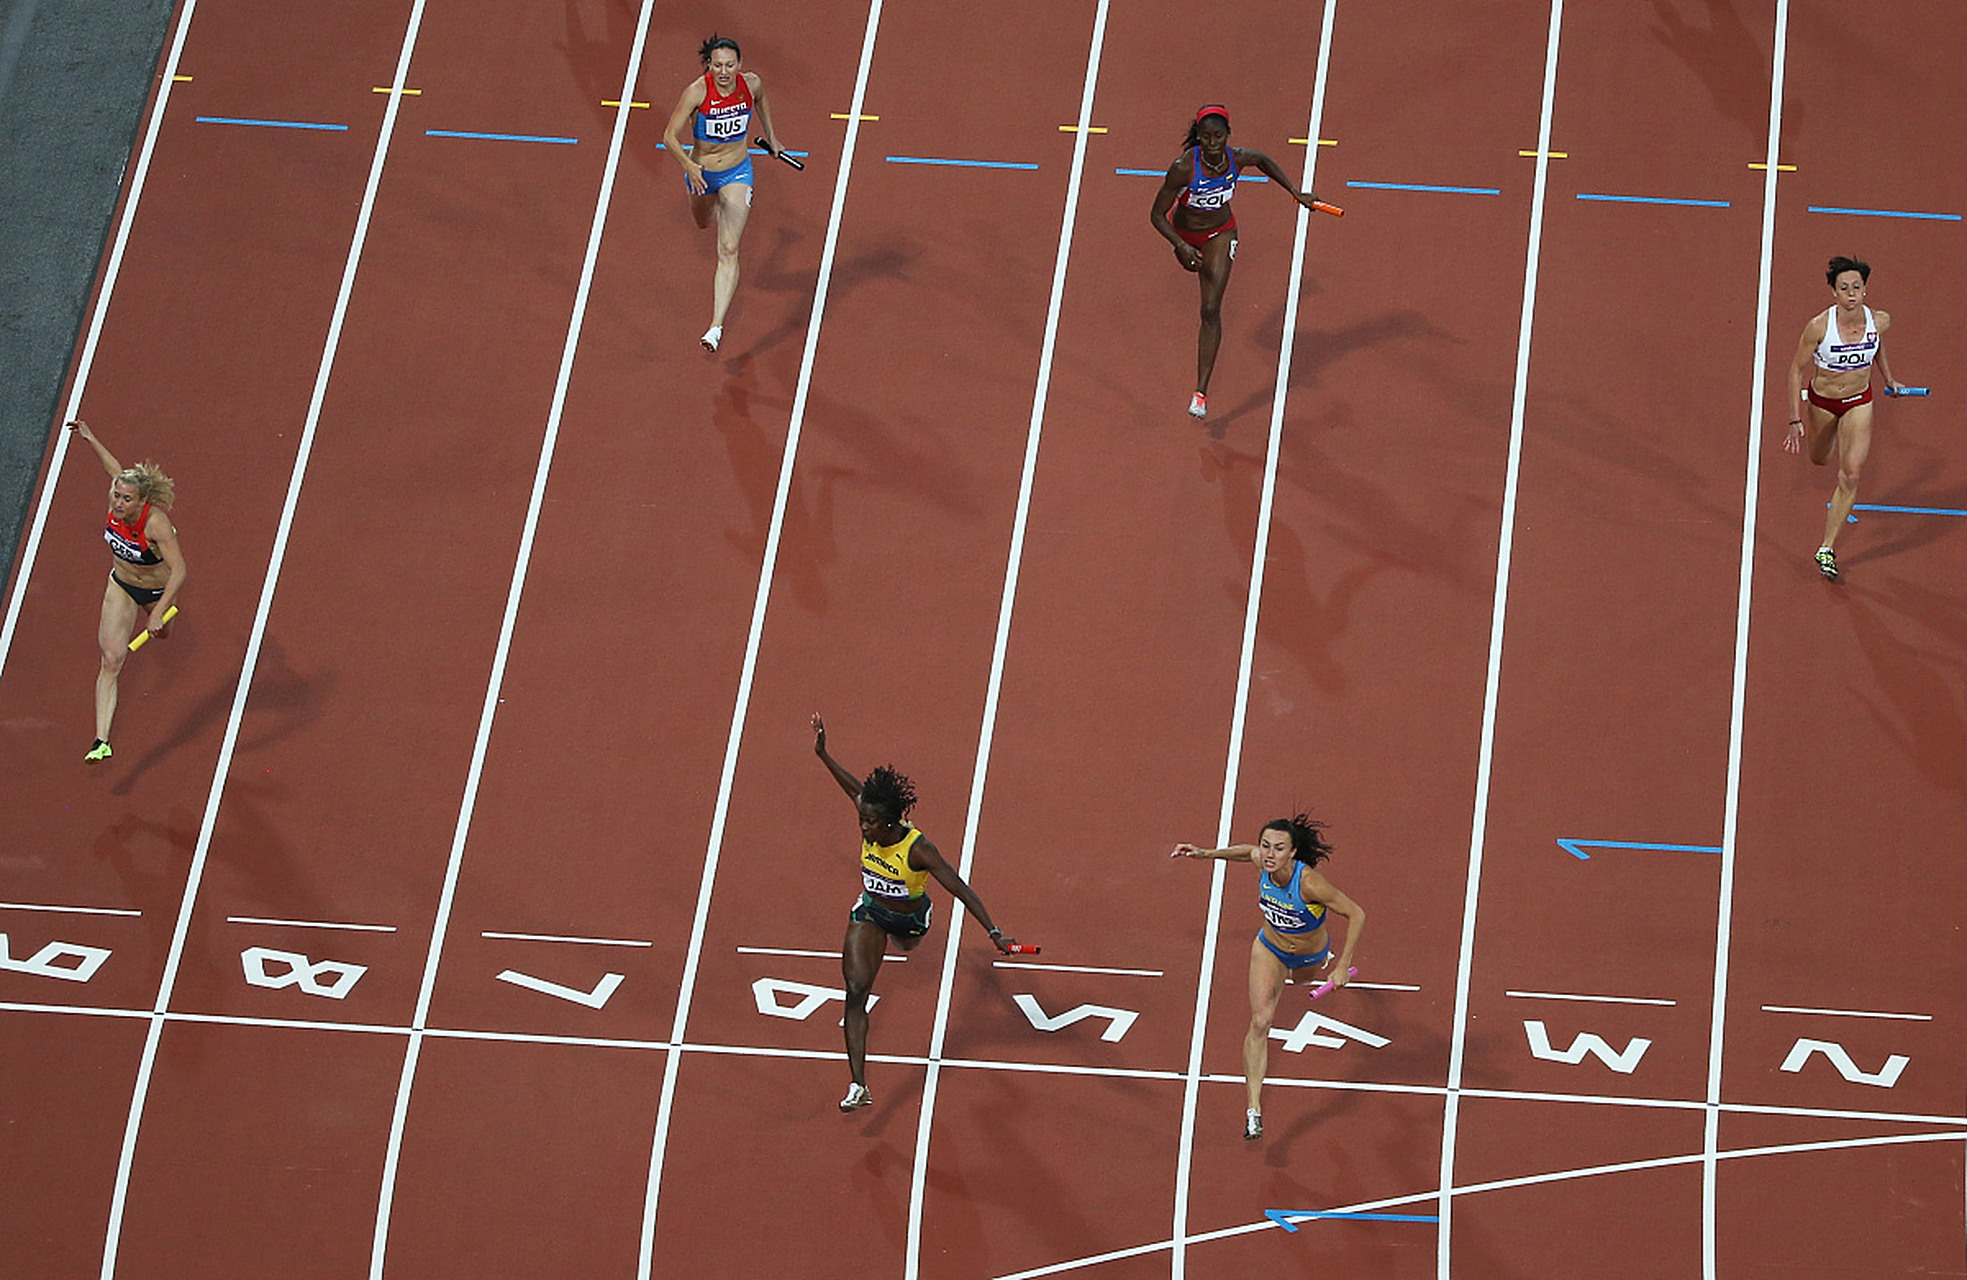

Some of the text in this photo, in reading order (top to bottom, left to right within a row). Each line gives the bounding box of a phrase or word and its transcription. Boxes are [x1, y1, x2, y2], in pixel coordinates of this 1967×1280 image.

[714, 119, 741, 135] RUS
[868, 879, 901, 894] JAM
[241, 947, 368, 999] 8
[495, 970, 625, 1009] 7
[752, 978, 880, 1027] 6
[1013, 995, 1139, 1042] 5
[1267, 1011, 1391, 1052] 4
[1524, 1021, 1652, 1073] 3
[1780, 1039, 1910, 1087] 2
